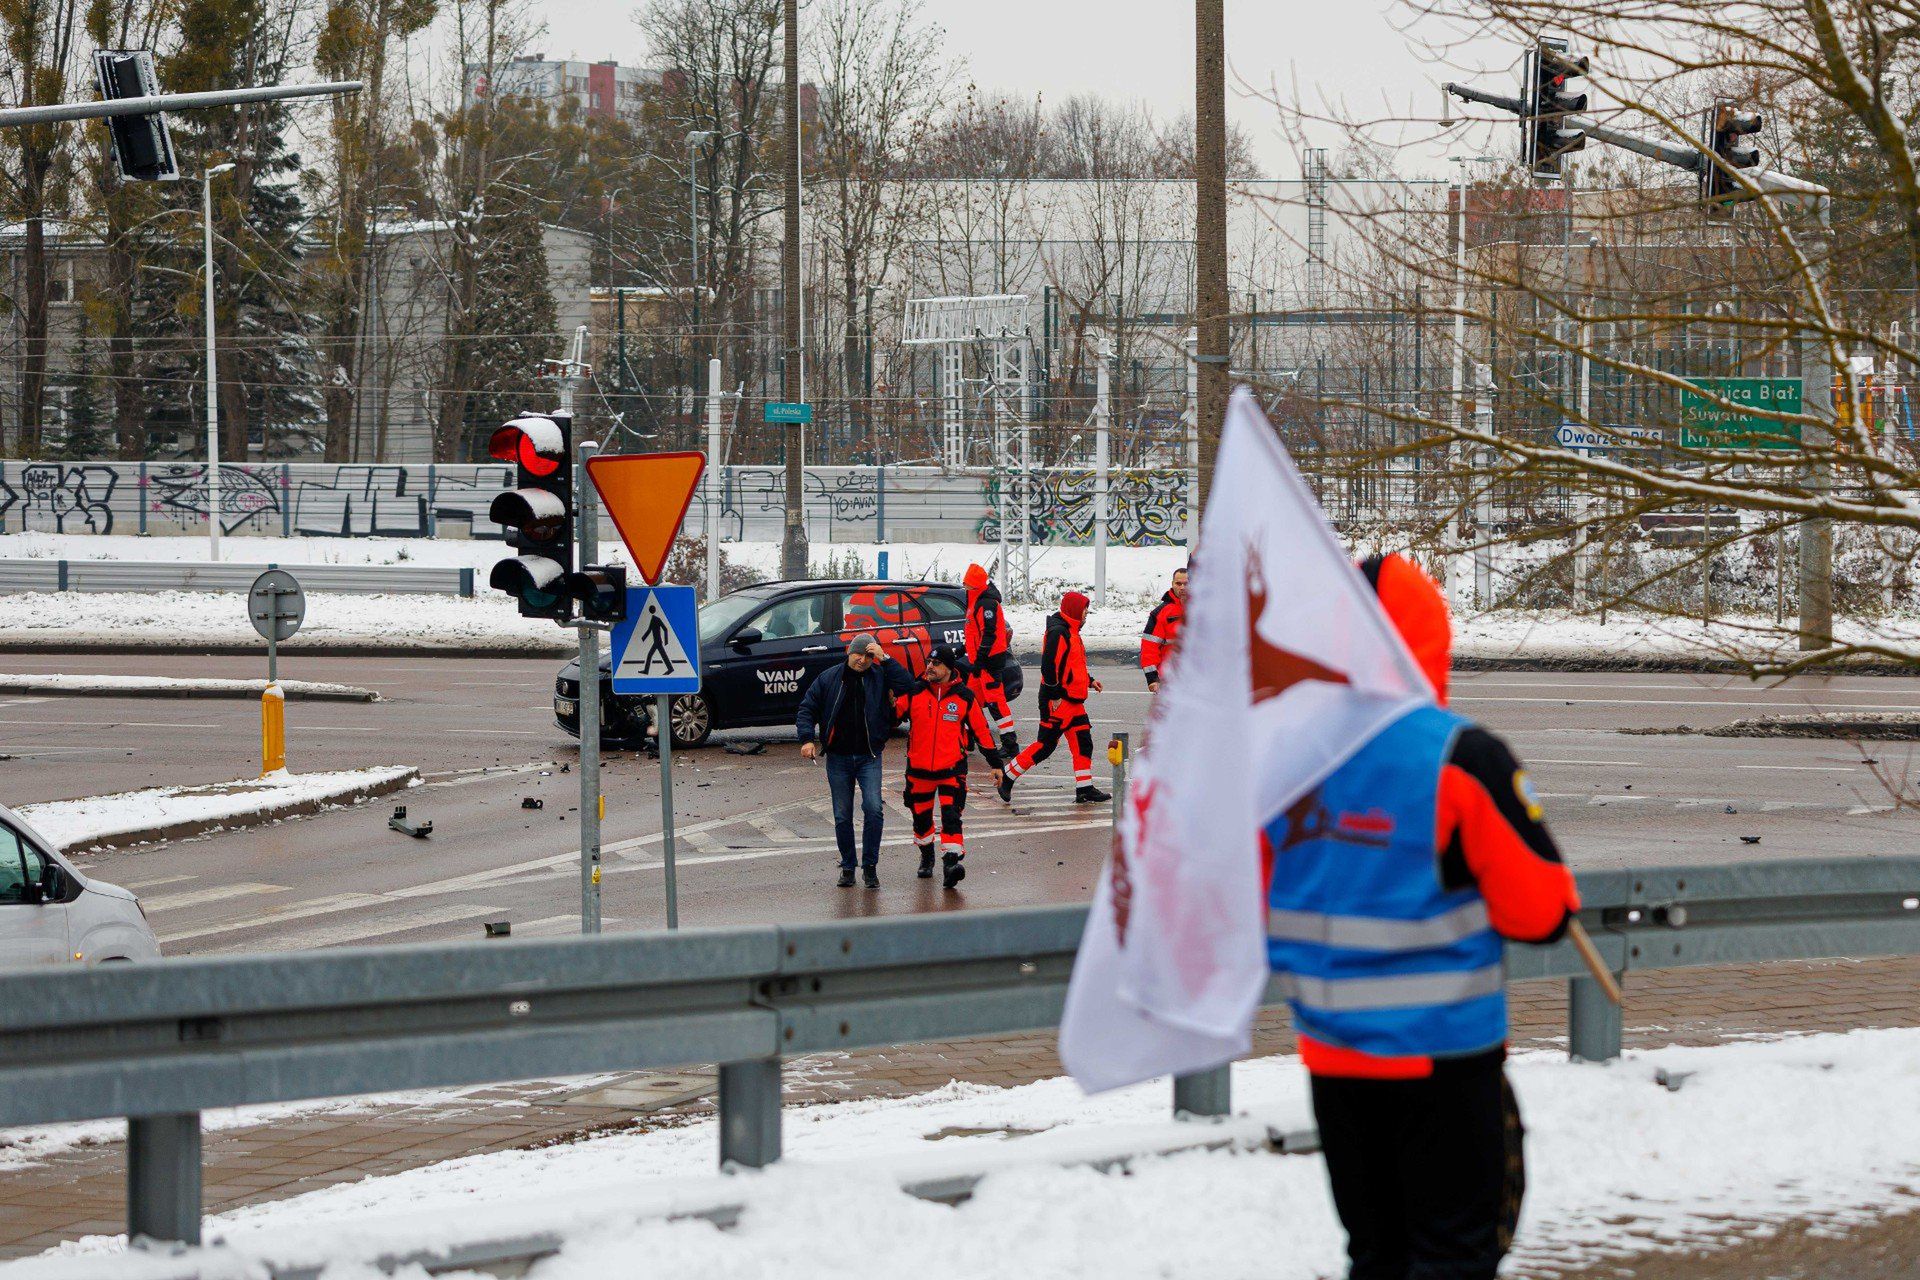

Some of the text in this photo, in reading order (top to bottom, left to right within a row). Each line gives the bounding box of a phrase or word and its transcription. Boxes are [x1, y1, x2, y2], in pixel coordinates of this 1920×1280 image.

[1688, 385, 1751, 399] Knica
[1562, 429, 1627, 446] Dworzec
[943, 629, 967, 645] CZĘ
[764, 669, 795, 682] VAN
[764, 681, 799, 694] KING
